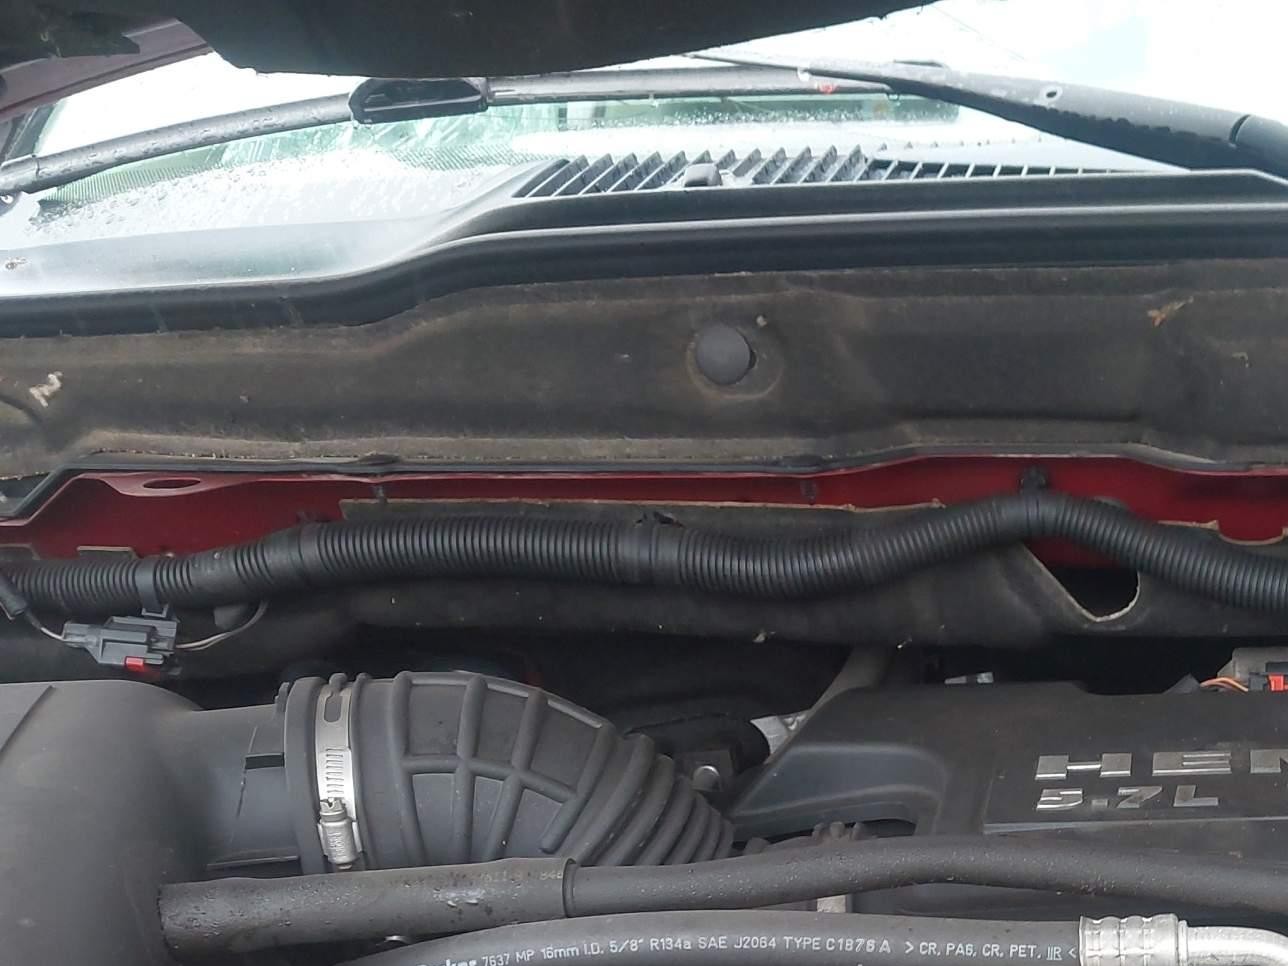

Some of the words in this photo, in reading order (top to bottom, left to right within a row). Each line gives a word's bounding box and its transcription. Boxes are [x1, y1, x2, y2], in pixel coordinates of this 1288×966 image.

[1036, 784, 1219, 810] 5.7L
[515, 949, 535, 964] MP
[541, 945, 580, 960] 16mm
[583, 942, 605, 956] I.D.
[650, 936, 692, 951] R134a
[698, 936, 728, 950] SAE
[734, 936, 777, 950] J2064
[784, 936, 821, 951] TYPE
